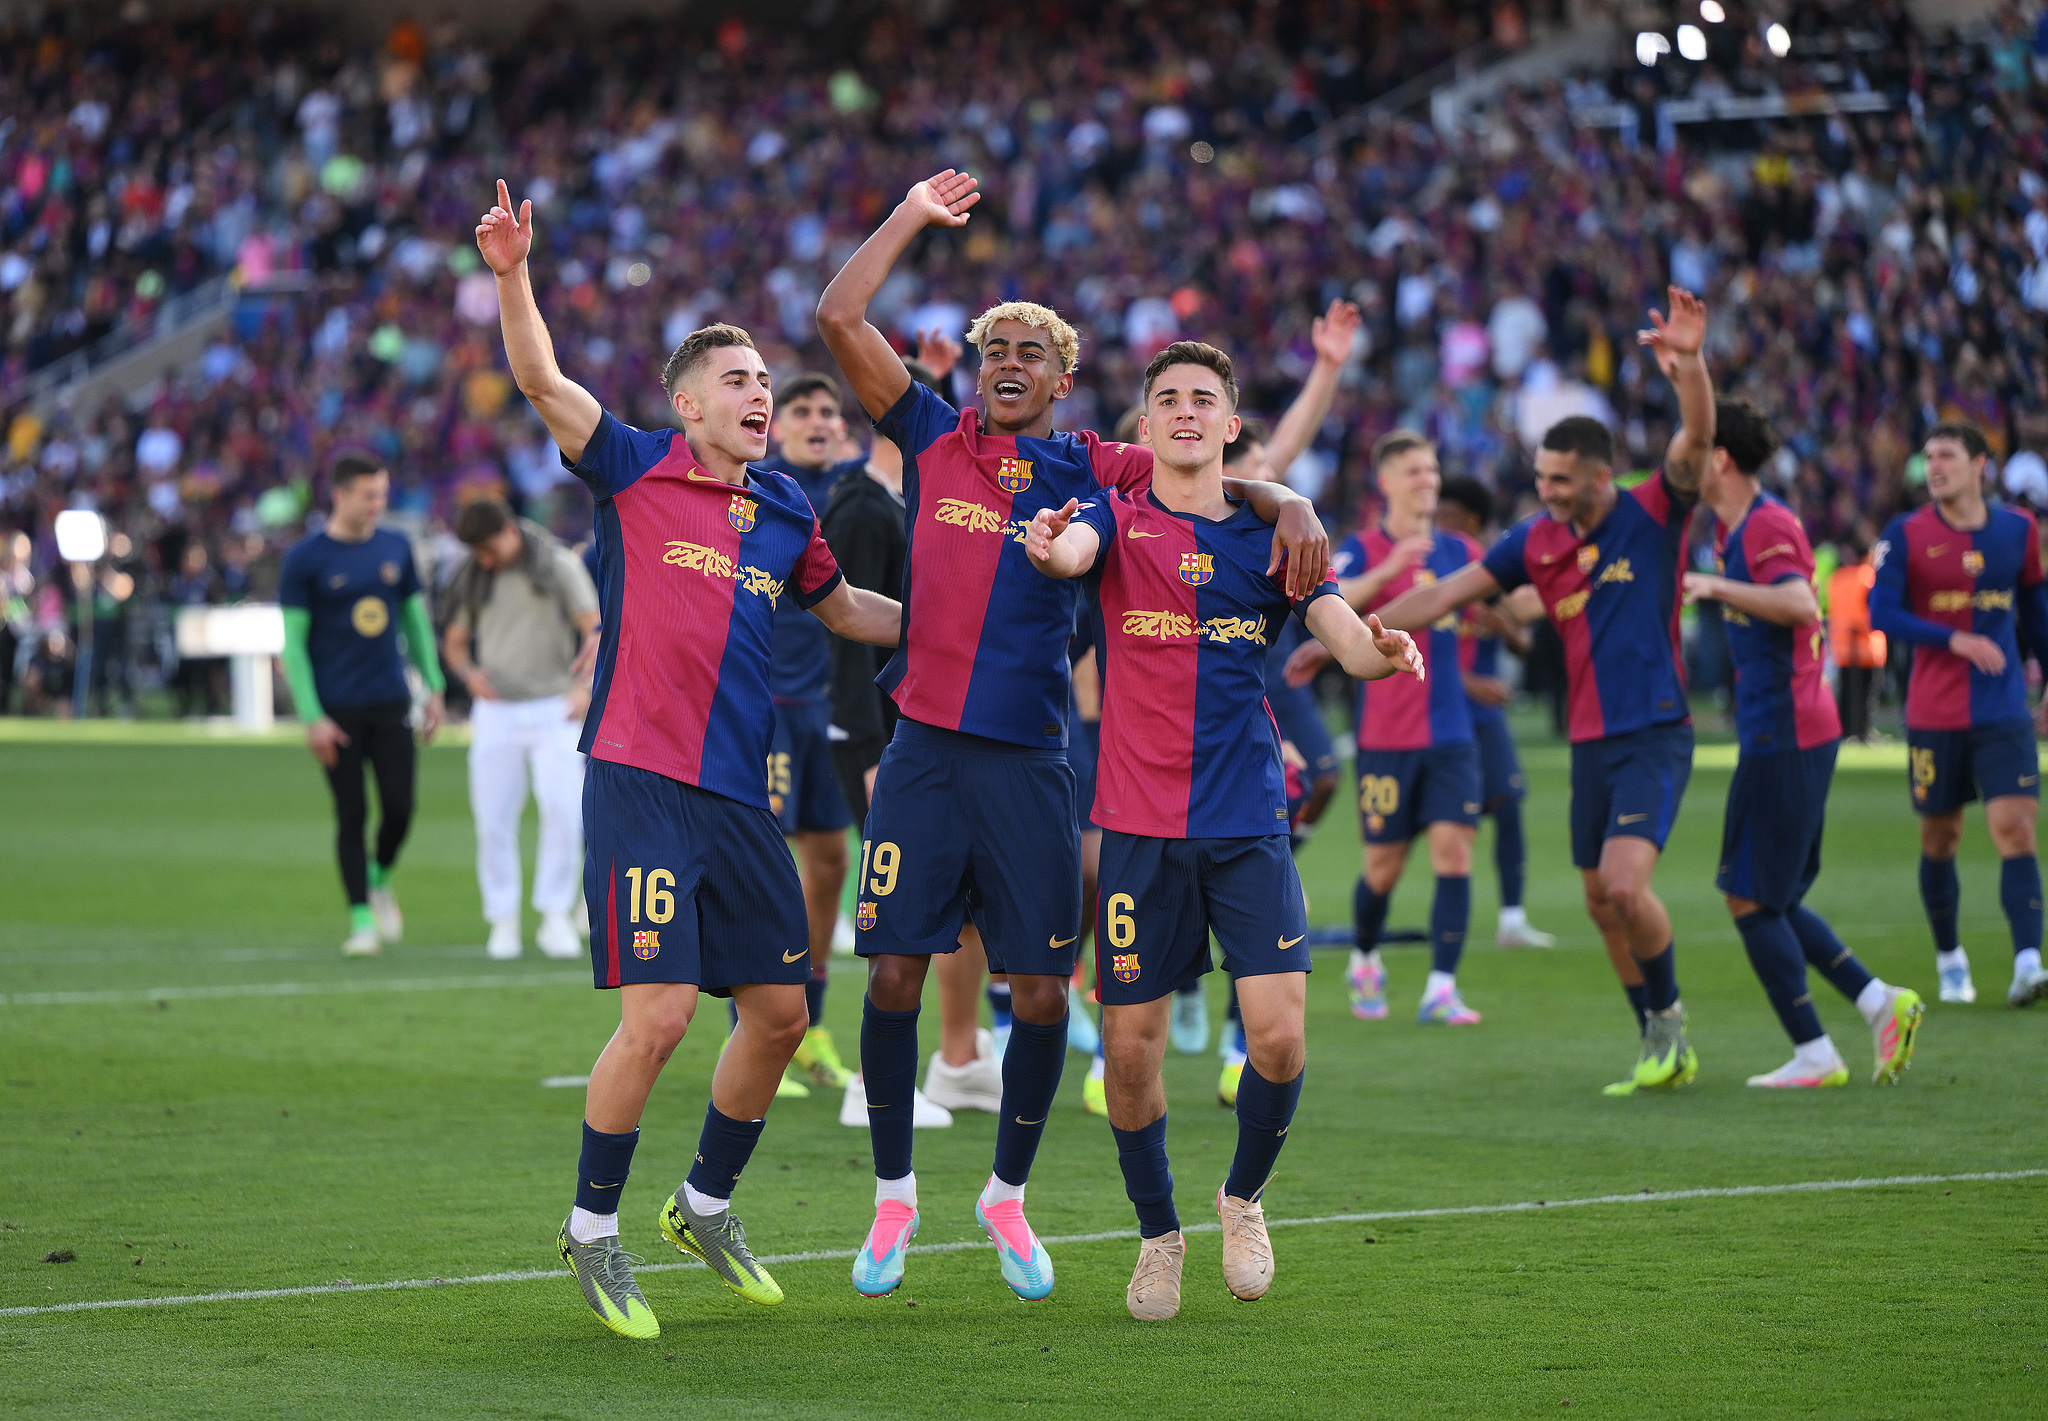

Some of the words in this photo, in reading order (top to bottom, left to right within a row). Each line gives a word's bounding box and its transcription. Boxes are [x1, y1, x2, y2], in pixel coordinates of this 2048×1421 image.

[1361, 773, 1399, 816] 20
[625, 867, 676, 924] 16
[860, 840, 901, 896] 19
[1107, 893, 1136, 948] 6
